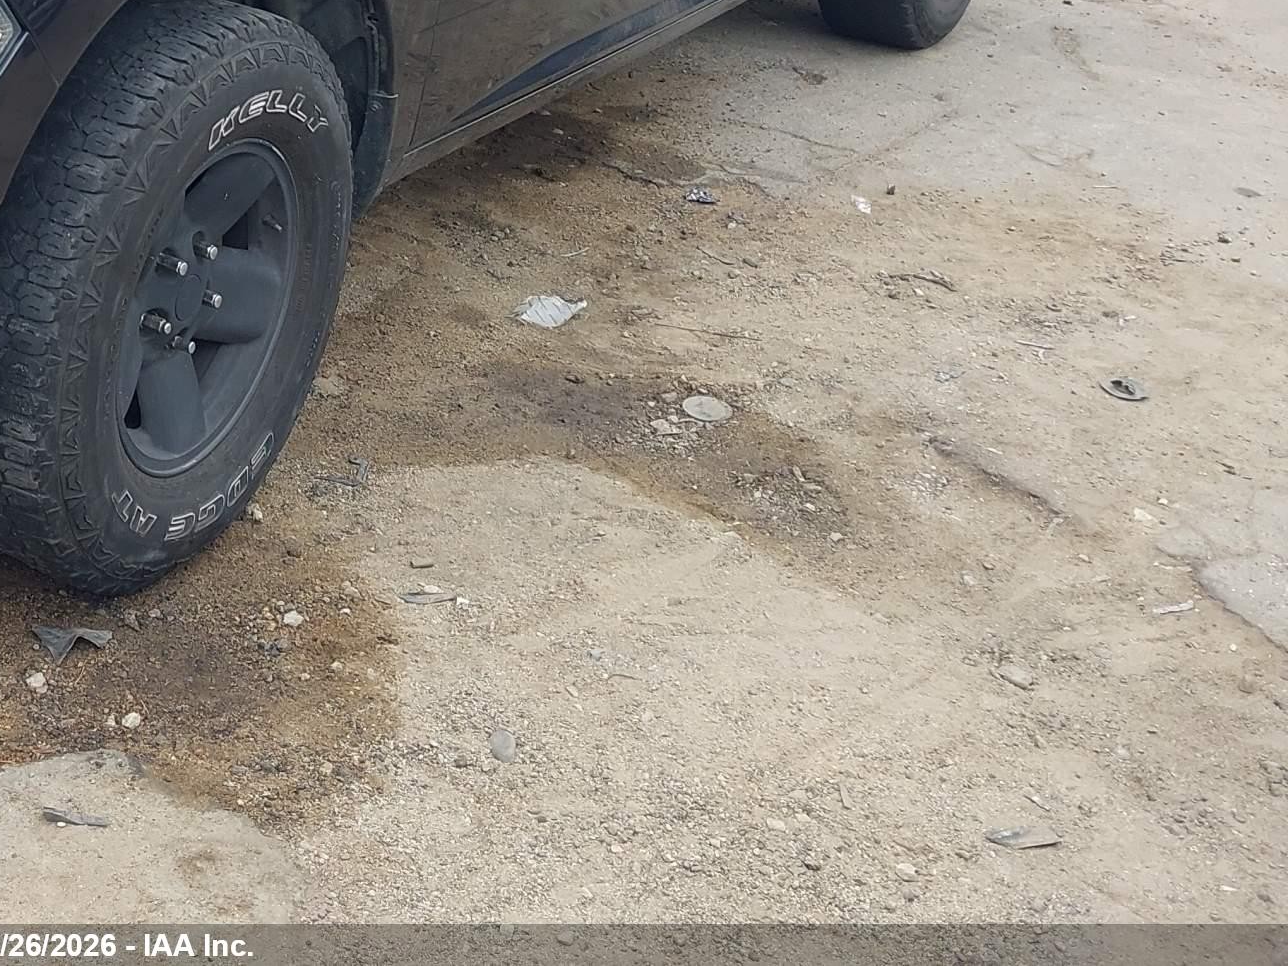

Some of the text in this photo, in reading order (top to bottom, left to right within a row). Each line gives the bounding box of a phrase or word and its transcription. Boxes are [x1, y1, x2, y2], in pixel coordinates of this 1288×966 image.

[208, 89, 329, 151] KELLY
[111, 432, 275, 542] EDGE AT
